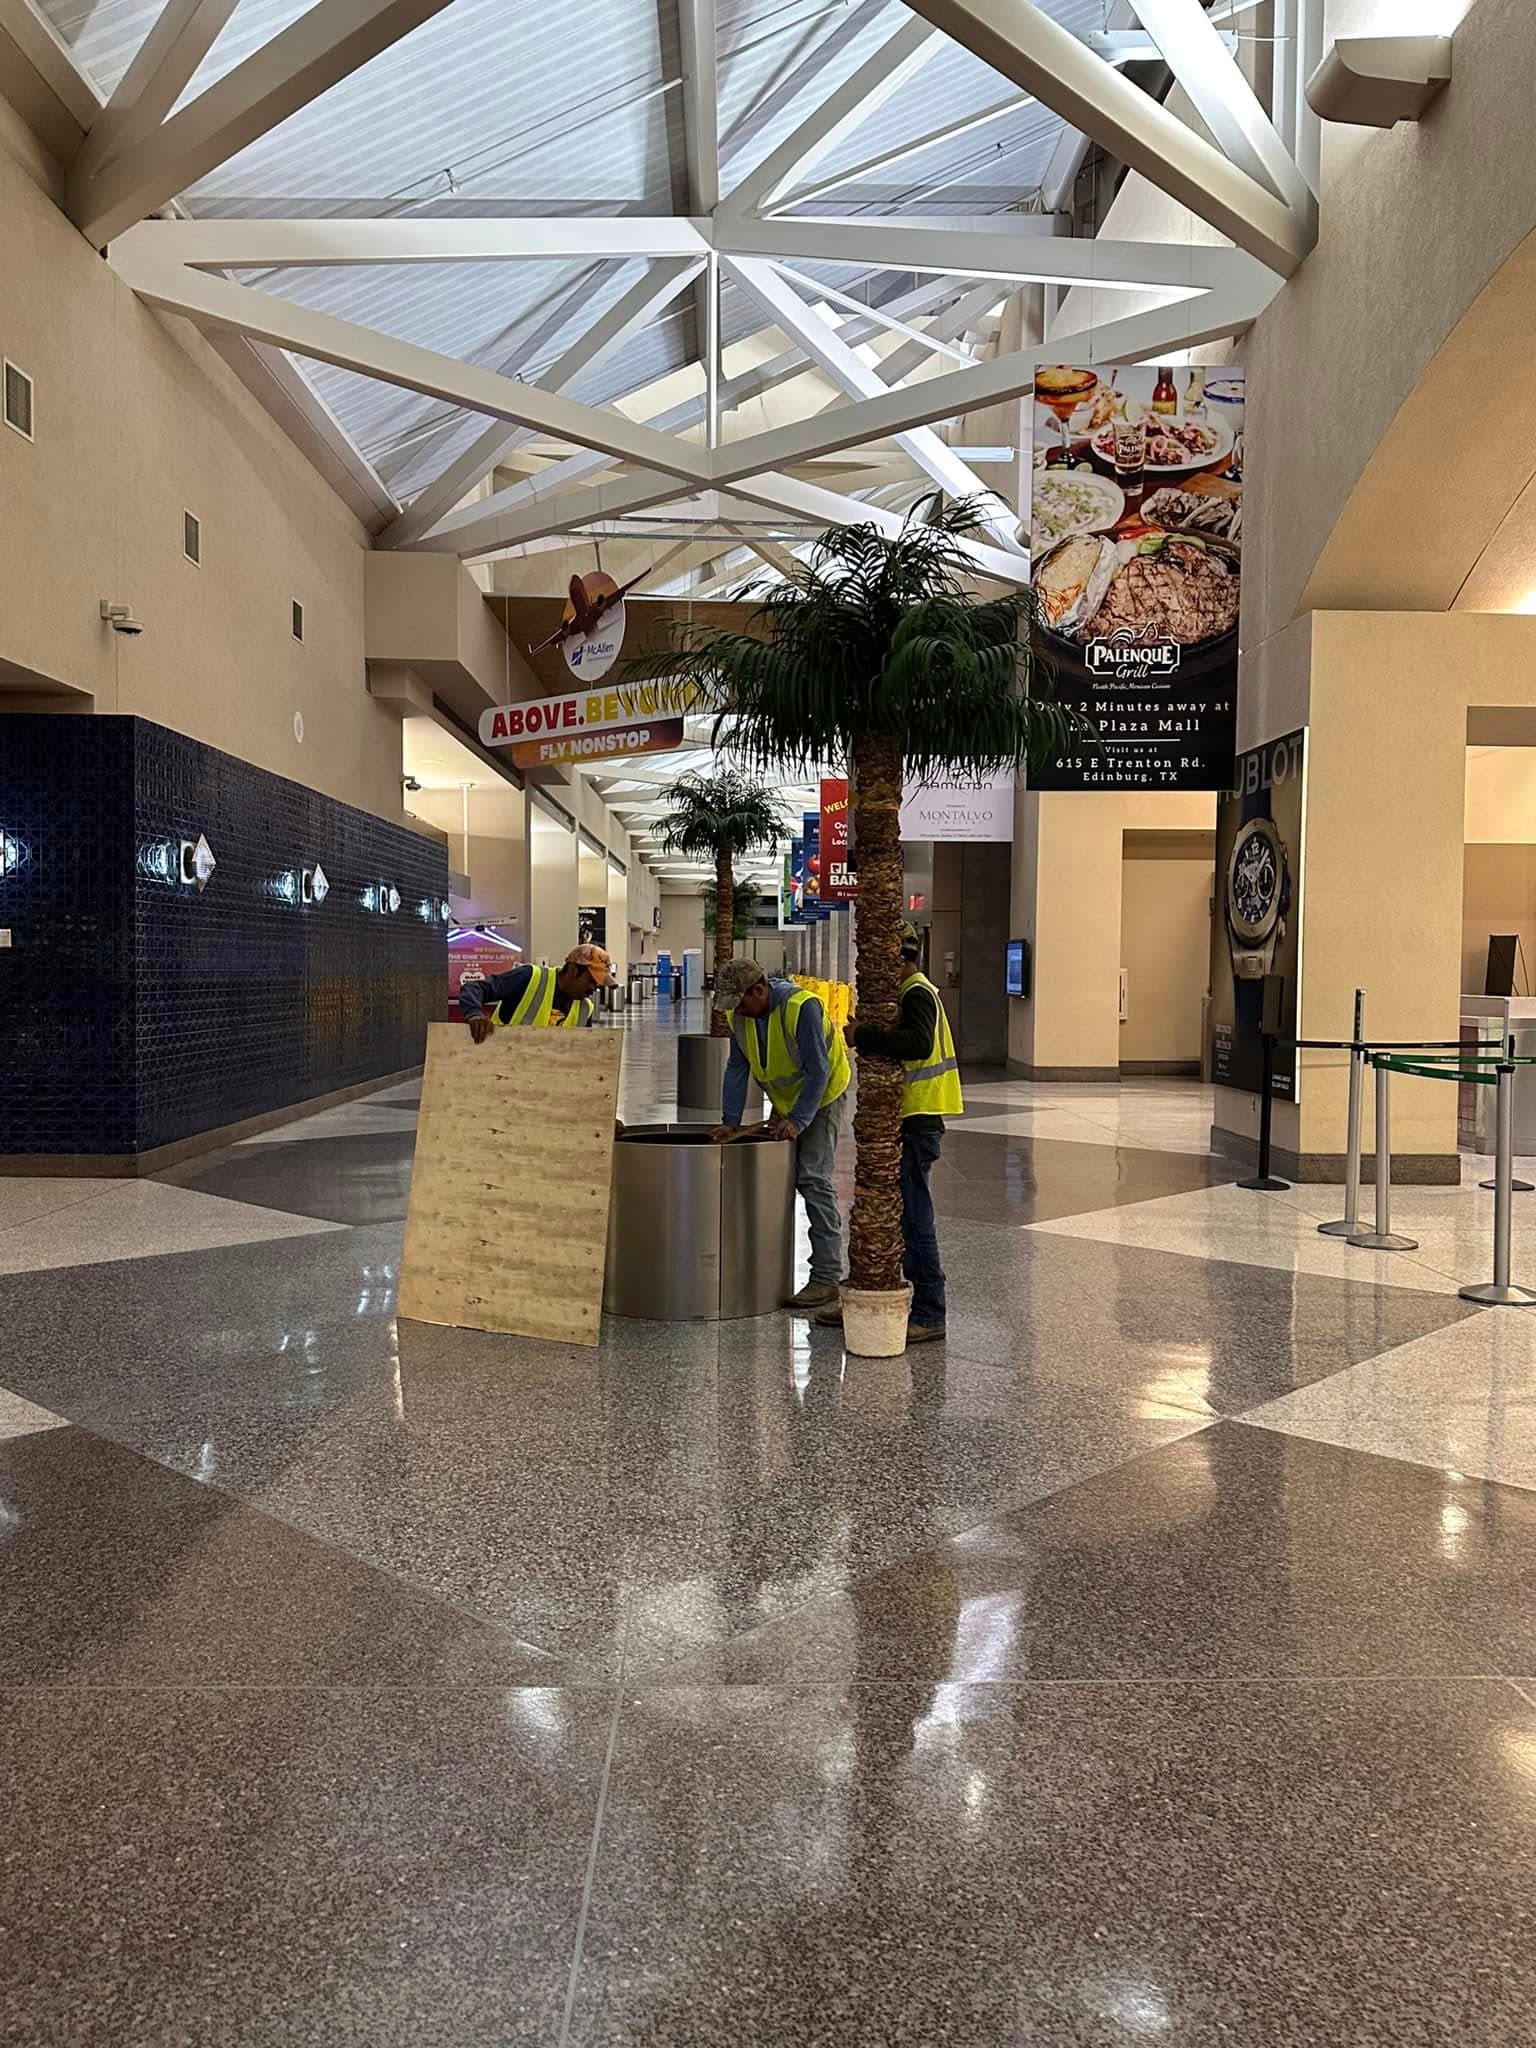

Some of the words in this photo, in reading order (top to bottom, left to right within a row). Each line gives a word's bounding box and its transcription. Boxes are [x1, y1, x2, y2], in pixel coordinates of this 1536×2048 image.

[1093, 646, 1174, 666] PALENQUE
[1116, 664, 1149, 678] Grill
[1080, 702, 1088, 711] 2
[1096, 701, 1160, 712] Minutes
[1167, 703, 1207, 713] away
[1214, 702, 1230, 712] at
[1100, 720, 1149, 732] Plaza
[1158, 719, 1201, 732] Mall
[540, 742, 567, 761] FLY
[570, 730, 651, 756] NONSTOP
[1105, 746, 1129, 754] Visit
[1056, 758, 1083, 769] 615
[1091, 758, 1099, 769] E
[1107, 758, 1172, 768] Trenton
[1180, 757, 1206, 768] Rd.
[1083, 771, 1153, 783] Edinburg,
[1160, 771, 1179, 781] TX
[920, 810, 993, 821] MONTALVO
